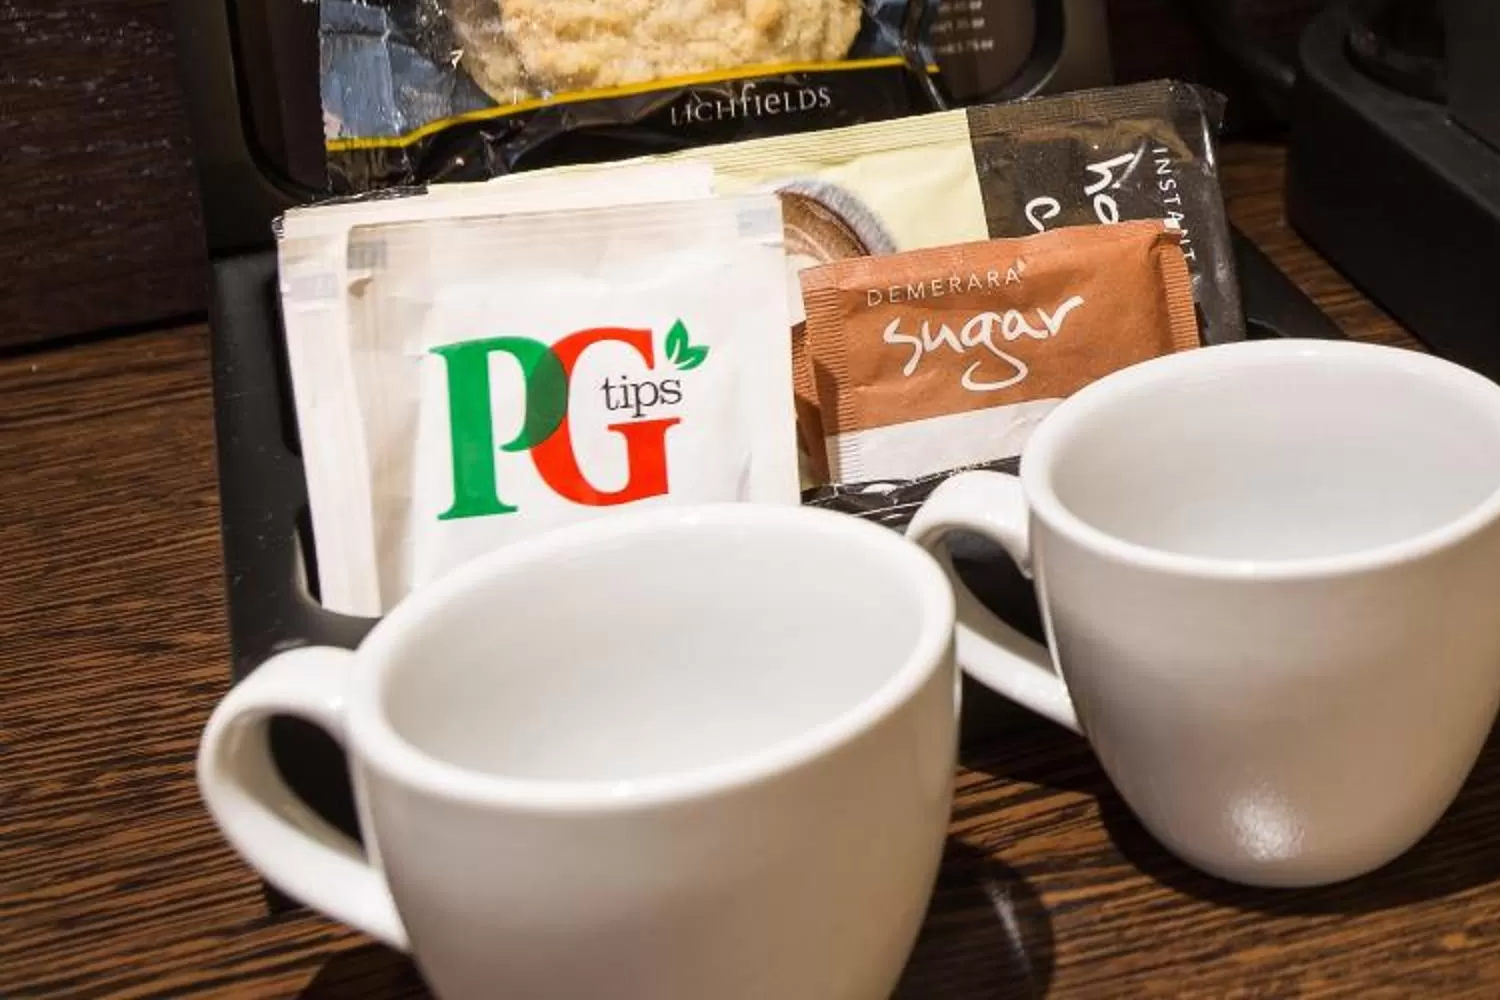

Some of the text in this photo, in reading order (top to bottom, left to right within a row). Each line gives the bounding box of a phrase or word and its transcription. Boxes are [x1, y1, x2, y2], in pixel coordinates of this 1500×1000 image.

[867, 268, 1019, 308] DEMERARA
[882, 296, 1085, 392] sugar
[428, 327, 681, 521] PG
[600, 375, 683, 418] tips
